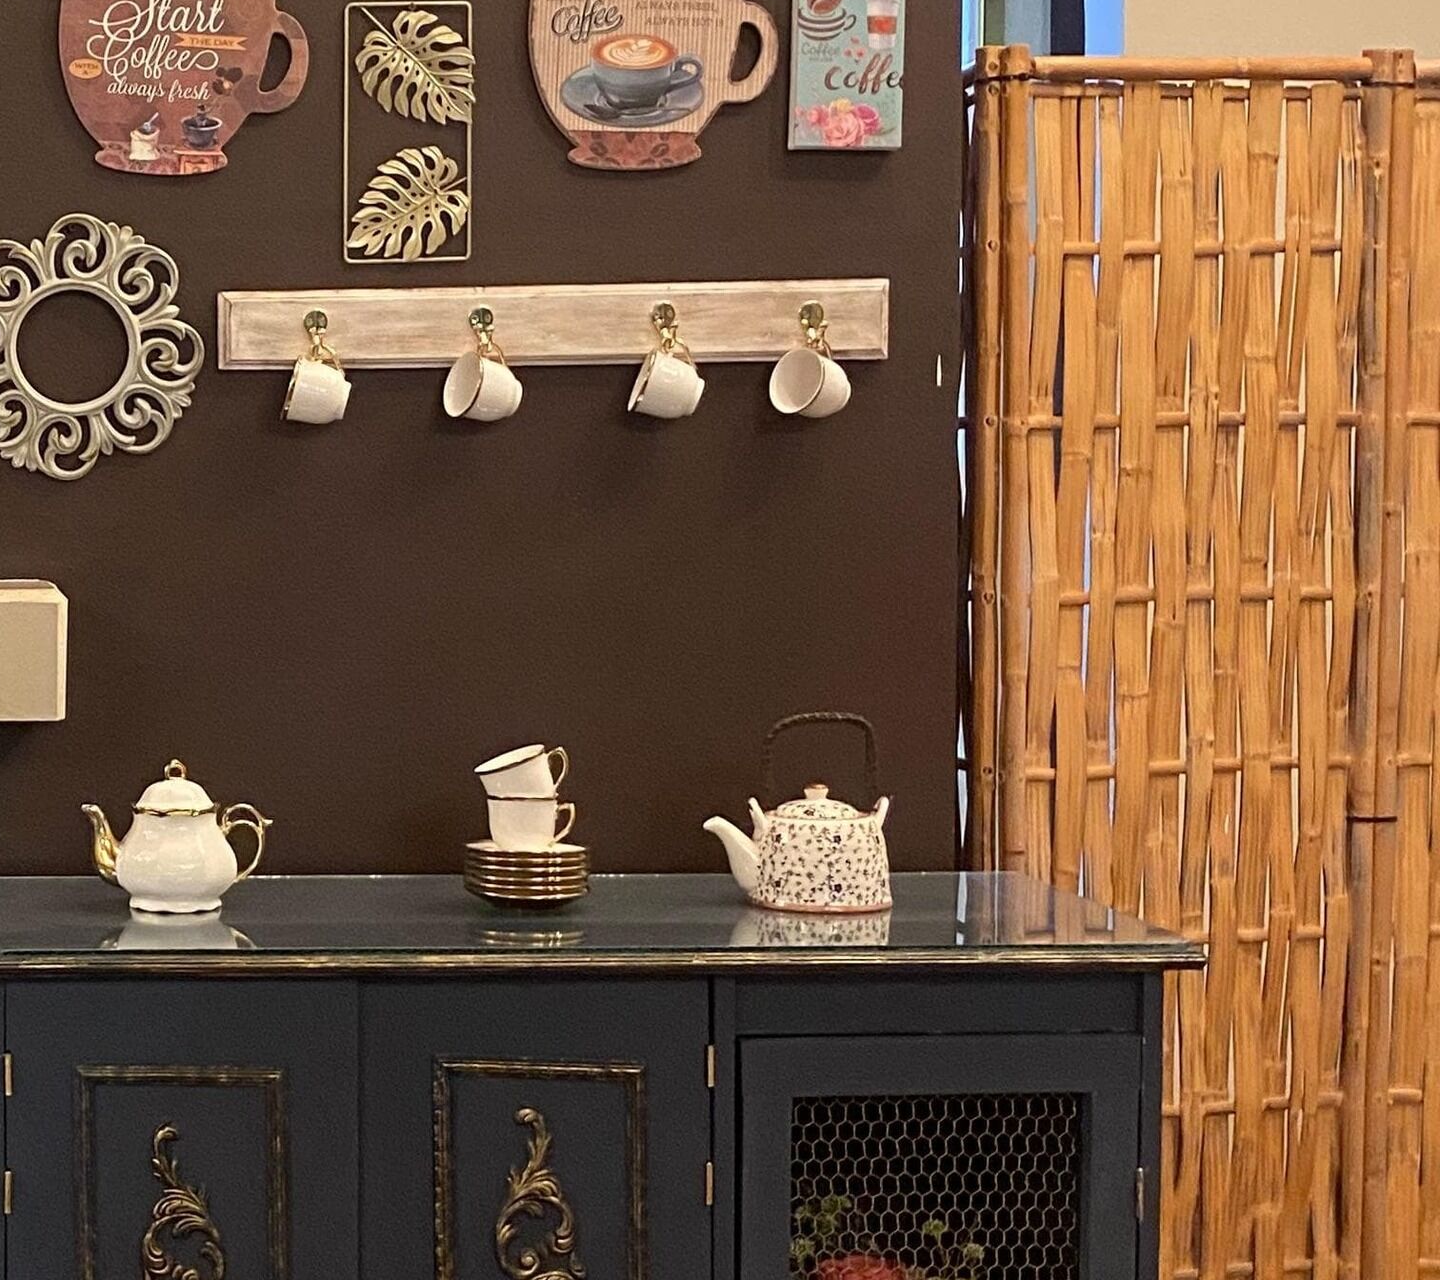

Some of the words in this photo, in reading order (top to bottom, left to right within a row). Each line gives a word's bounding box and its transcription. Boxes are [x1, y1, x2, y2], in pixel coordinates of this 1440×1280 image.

[86, 27, 220, 83] Coffee
[107, 78, 165, 102] always
[168, 80, 211, 103] fresh
